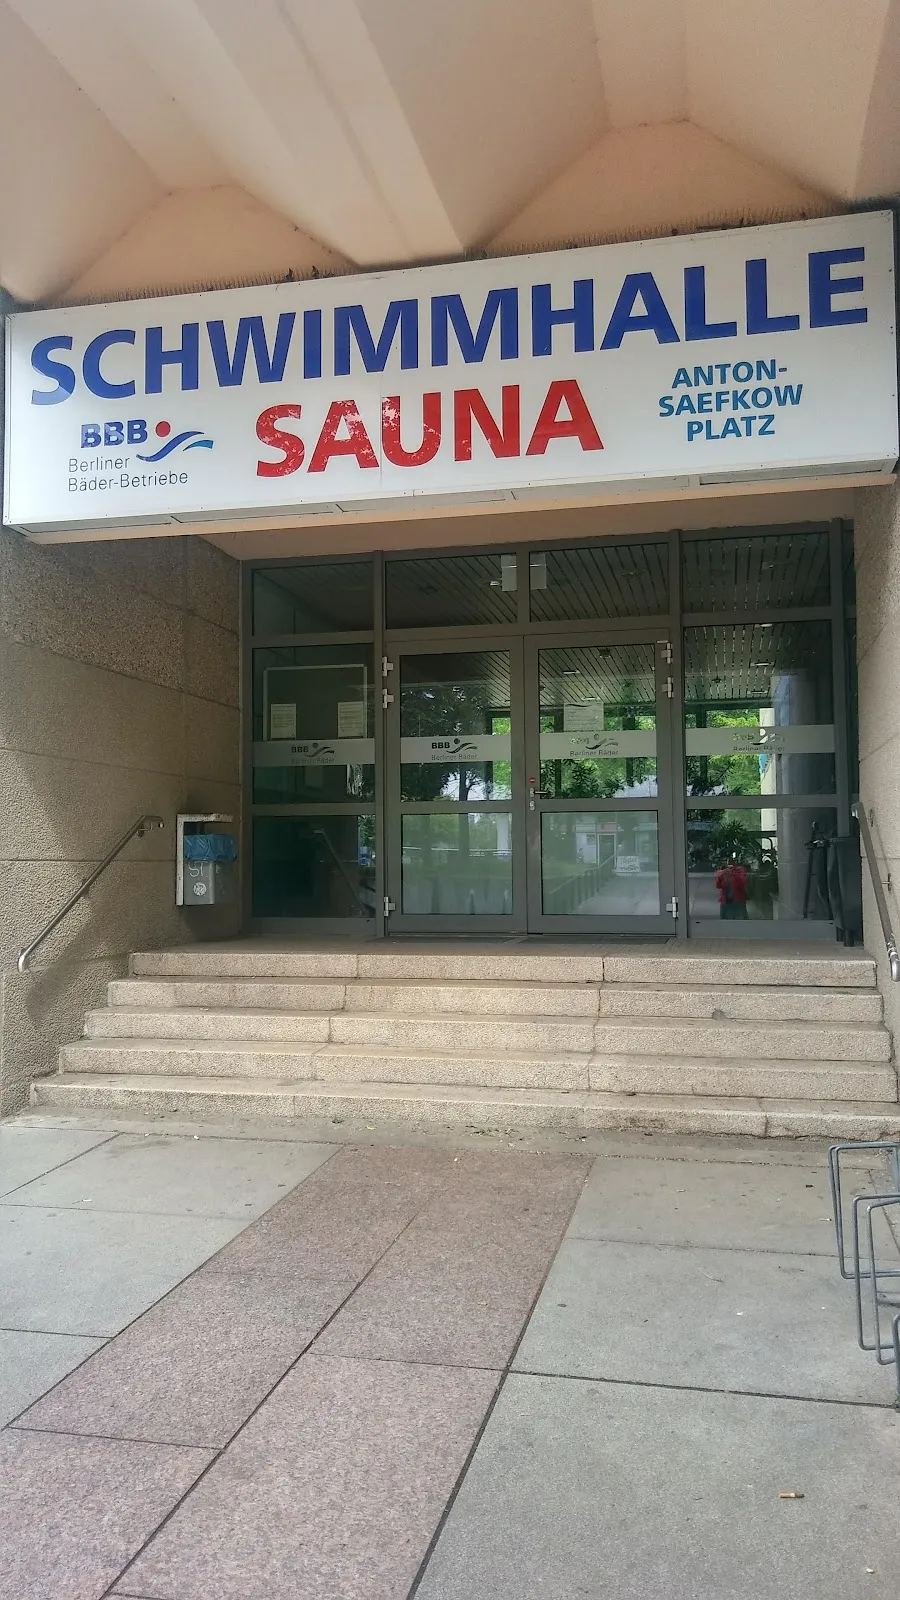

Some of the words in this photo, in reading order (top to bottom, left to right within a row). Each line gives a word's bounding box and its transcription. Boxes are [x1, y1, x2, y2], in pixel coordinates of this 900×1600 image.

[31, 246, 868, 405] SCHWIMMHALLE
[671, 358, 788, 389] ANTON-
[658, 383, 804, 418] SAEFKOW
[80, 419, 148, 449] BBB
[255, 379, 604, 478] SAUNA
[686, 414, 776, 442] PLATZ
[68, 456, 131, 473] Berliner
[68, 470, 189, 492] Bäder-Betriebe
